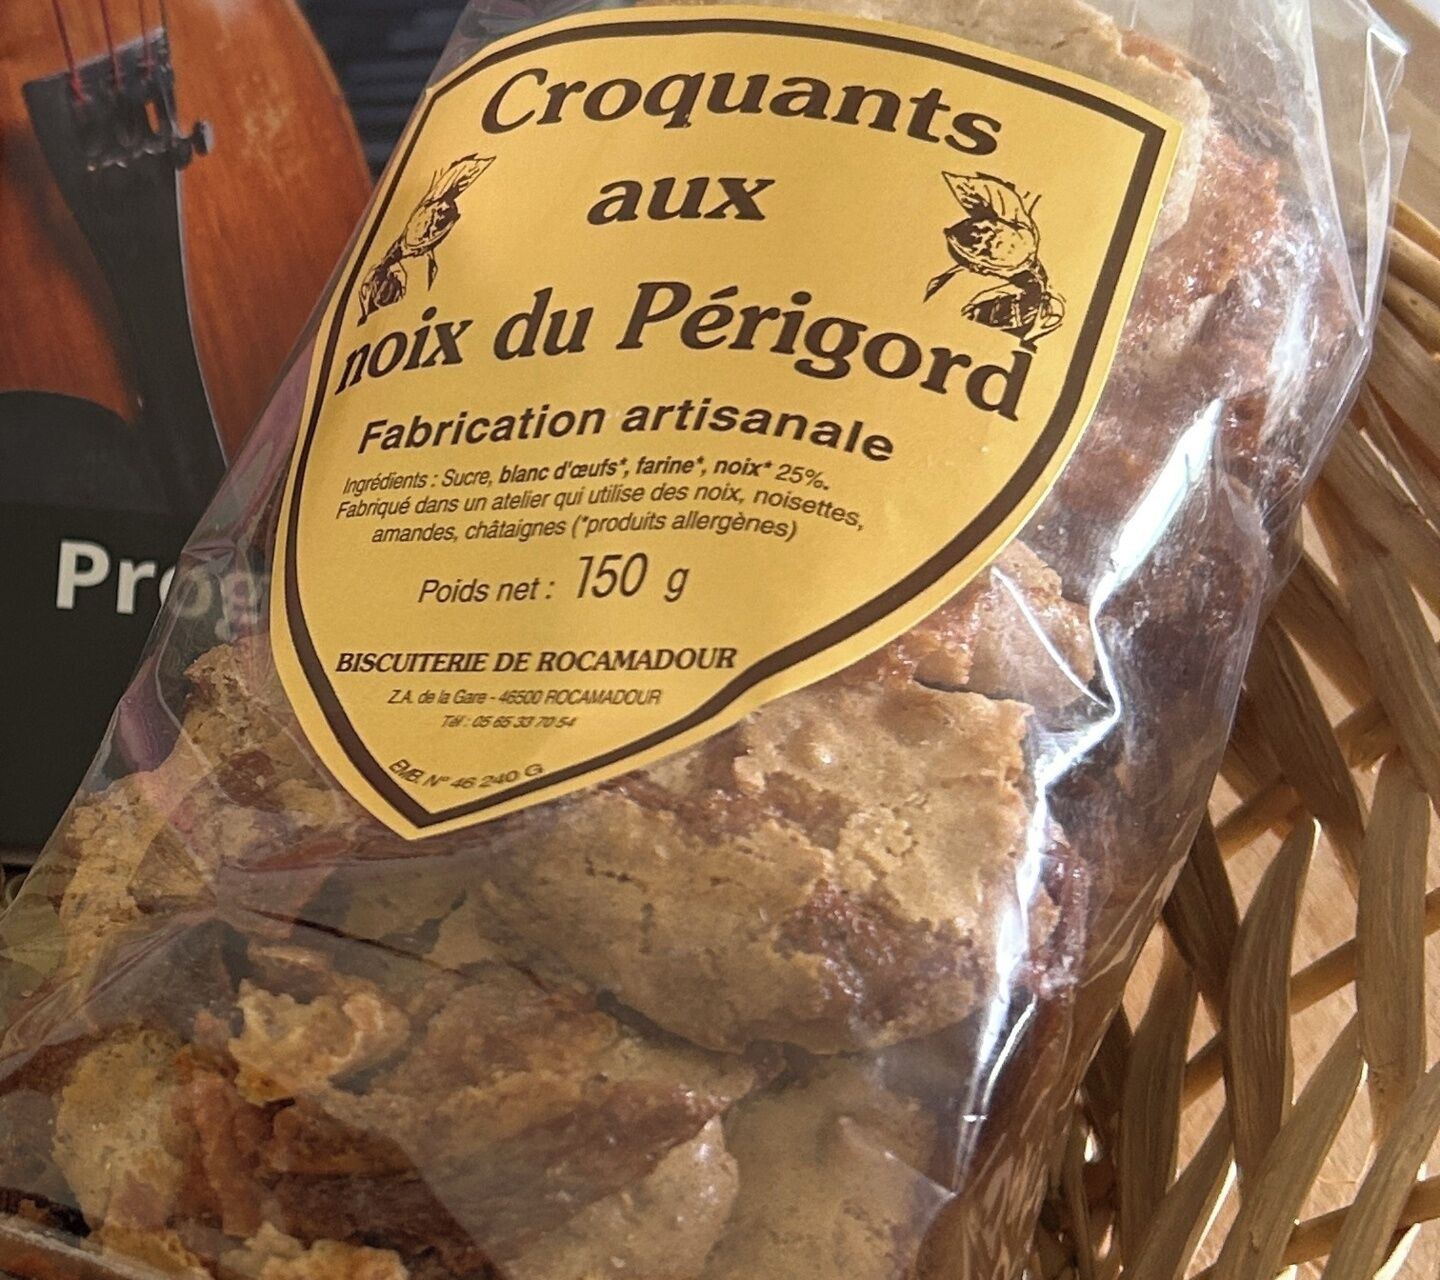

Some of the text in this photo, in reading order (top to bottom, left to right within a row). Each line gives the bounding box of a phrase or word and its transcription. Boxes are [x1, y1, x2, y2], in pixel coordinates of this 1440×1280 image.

[480, 67, 1002, 157] Croquants
[586, 174, 776, 226] aux
[334, 280, 1037, 424] noix du Périgord
[358, 397, 895, 463] Fabrication artisanale
[343, 471, 428, 498] Ingrédients
[441, 468, 495, 489] Sucre,
[498, 463, 549, 485] blanc
[774, 463, 832, 491] 25%.
[336, 481, 865, 532] Fabriqué dans un atelier qui utilise des noix, noisettes,
[371, 523, 459, 543] amandes,
[464, 518, 567, 543] châtaignes
[671, 510, 799, 543] allergènes)
[418, 578, 489, 604] Poids
[496, 578, 541, 603] net
[577, 552, 648, 600] 150
[664, 566, 691, 604] g
[335, 647, 738, 674] BISCUITERIE DE ROCAMADOUR
[417, 689, 436, 705] de
[437, 689, 450, 705] la
[452, 689, 486, 705] Gare
[498, 689, 543, 706] 46500
[544, 688, 663, 706] ROCAMADOUR
[471, 715, 492, 729] 05
[534, 715, 555, 729] 70
[554, 716, 578, 730] 54
[421, 773, 451, 788] N°
[450, 775, 475, 789] 46
[478, 770, 520, 789] 240
[523, 762, 545, 777] G
